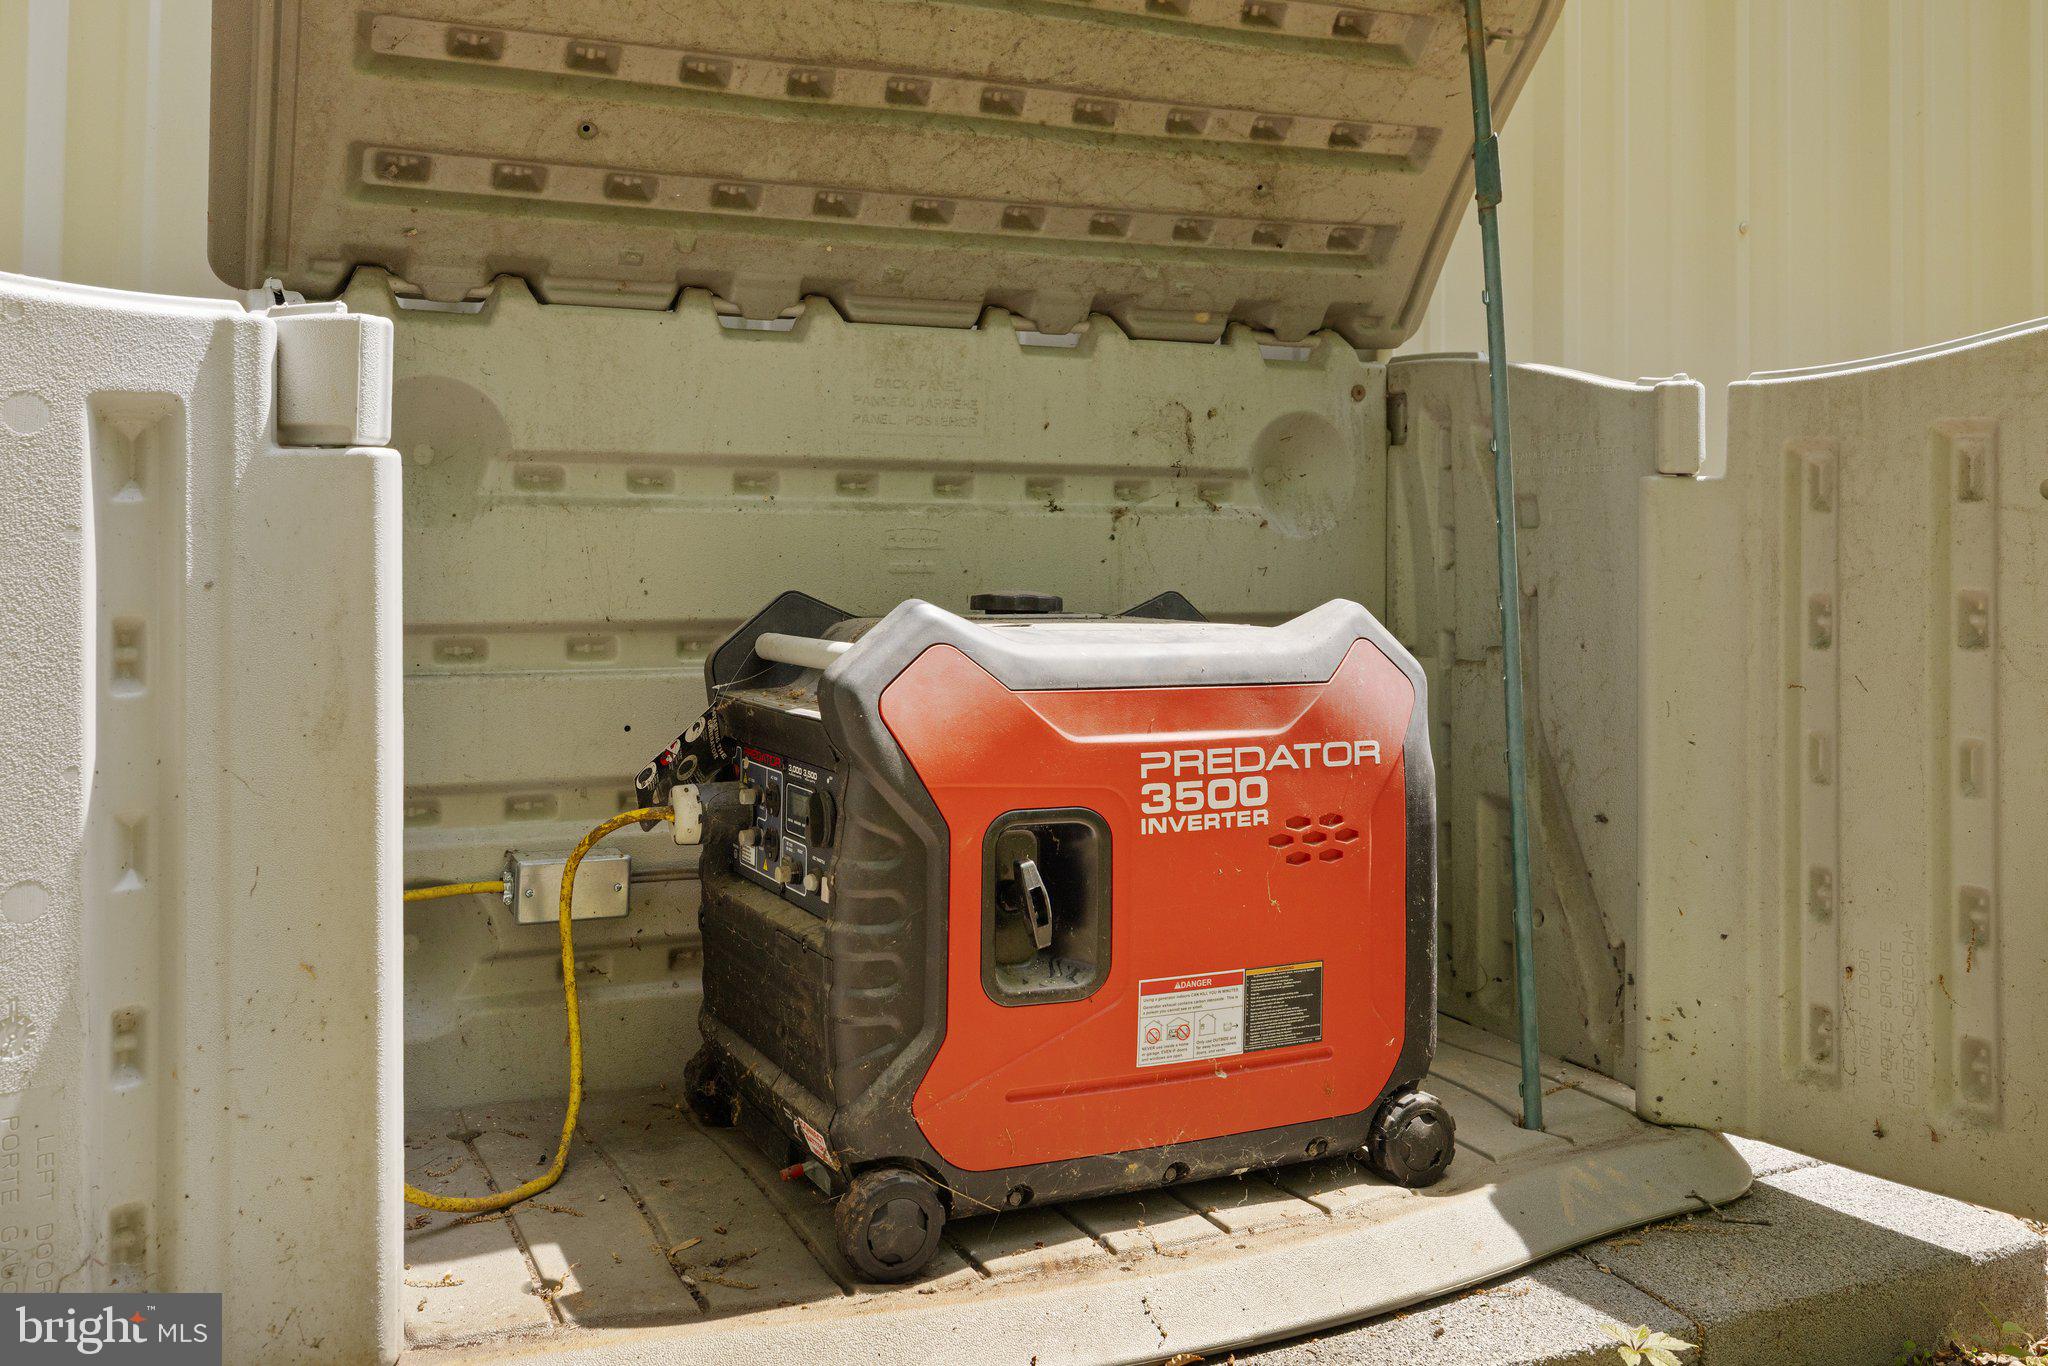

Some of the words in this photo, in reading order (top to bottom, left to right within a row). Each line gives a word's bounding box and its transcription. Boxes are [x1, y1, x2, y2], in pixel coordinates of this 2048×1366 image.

[1140, 740, 1380, 778] PREDATOR
[1141, 776, 1268, 814] 3500
[1140, 809, 1269, 835] INVERTER
[1180, 978, 1212, 989] DANGER
[1858, 949, 1871, 1000] DOOR
[1879, 940, 1893, 1008] DROITE
[1858, 1016, 1872, 1067] RIGHT
[1, 1115, 20, 1206] PORTE
[37, 1134, 55, 1201] LEFT
